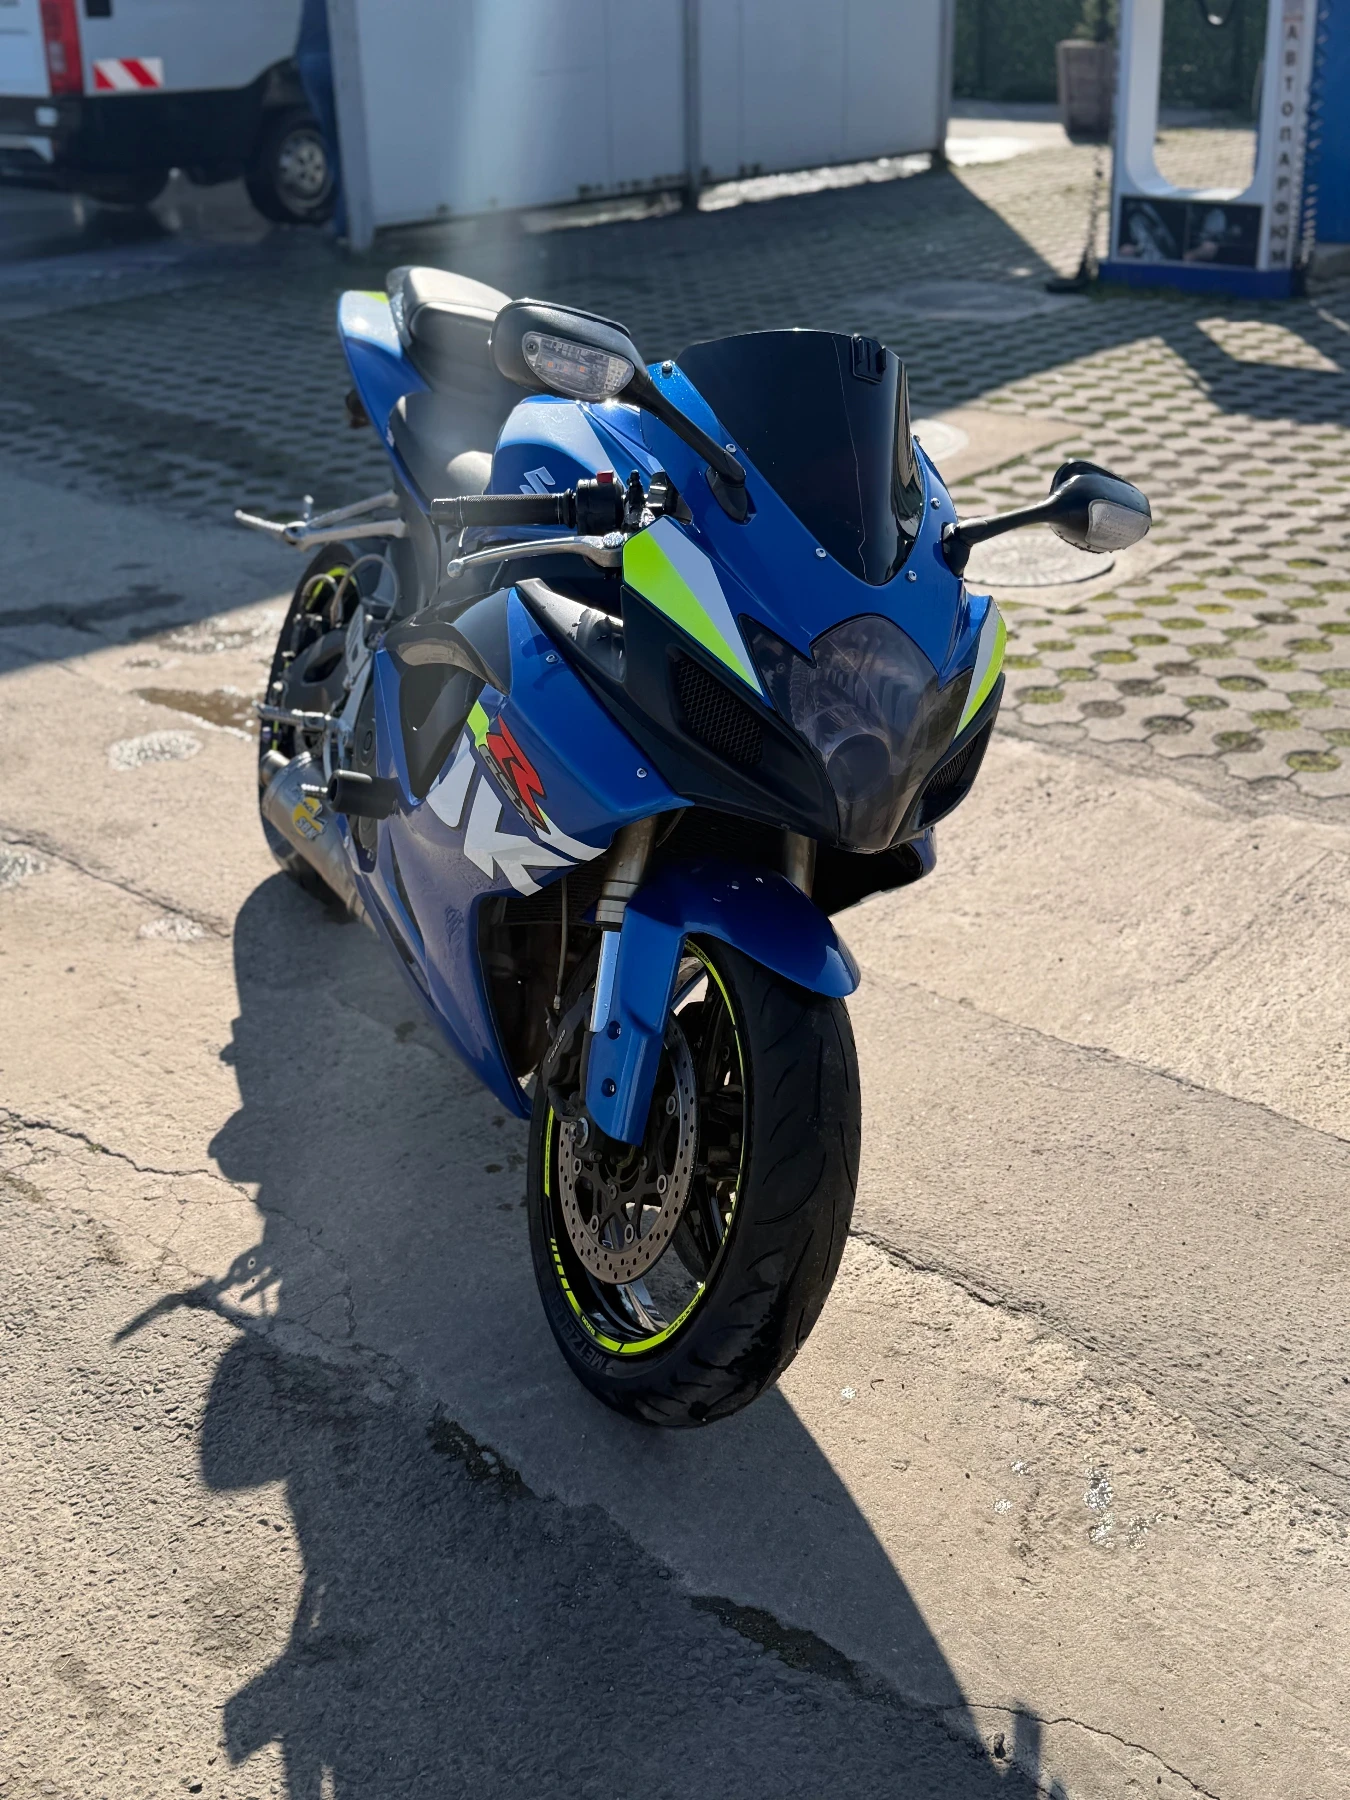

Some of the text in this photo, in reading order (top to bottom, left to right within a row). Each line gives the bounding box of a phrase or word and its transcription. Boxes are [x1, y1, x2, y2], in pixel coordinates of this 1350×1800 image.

[478, 744, 541, 835] GSX
[486, 713, 551, 836] R
[296, 816, 319, 841] SBK
